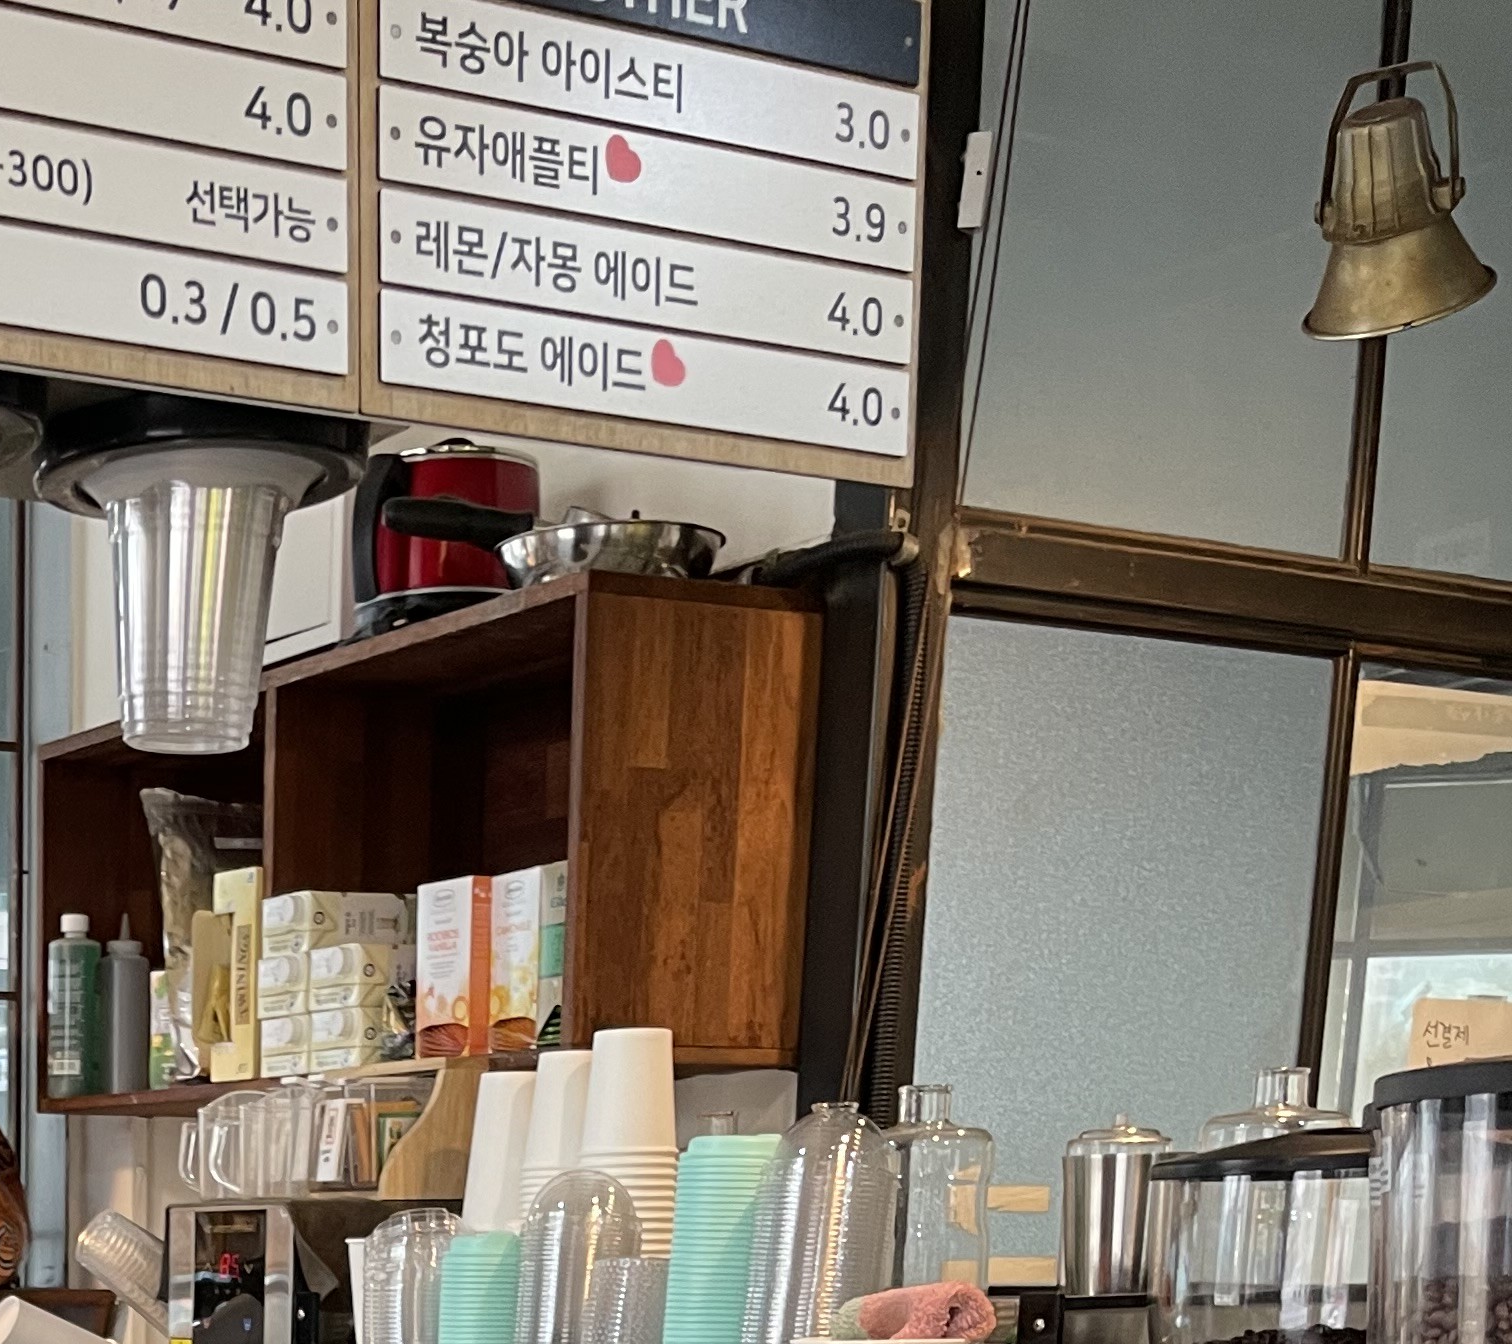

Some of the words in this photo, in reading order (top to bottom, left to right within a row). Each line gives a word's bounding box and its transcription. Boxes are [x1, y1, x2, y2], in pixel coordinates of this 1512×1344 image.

[244, 86, 312, 138] 4.0
[415, 12, 529, 82] 복숭아
[541, 38, 685, 114] 아이스티
[834, 102, 890, 151] 3.0
[187, 178, 317, 244] 선택가능
[414, 115, 600, 196] 유자애플티
[831, 196, 886, 243] 3.9
[415, 219, 582, 295] 레몬/자몽
[595, 251, 699, 307] 에이드
[827, 291, 884, 337] 4.0
[418, 312, 529, 376] 청포도
[541, 335, 647, 392] 에이드
[827, 382, 884, 427] 4.0
[1422, 1020, 1469, 1049] 선결제
